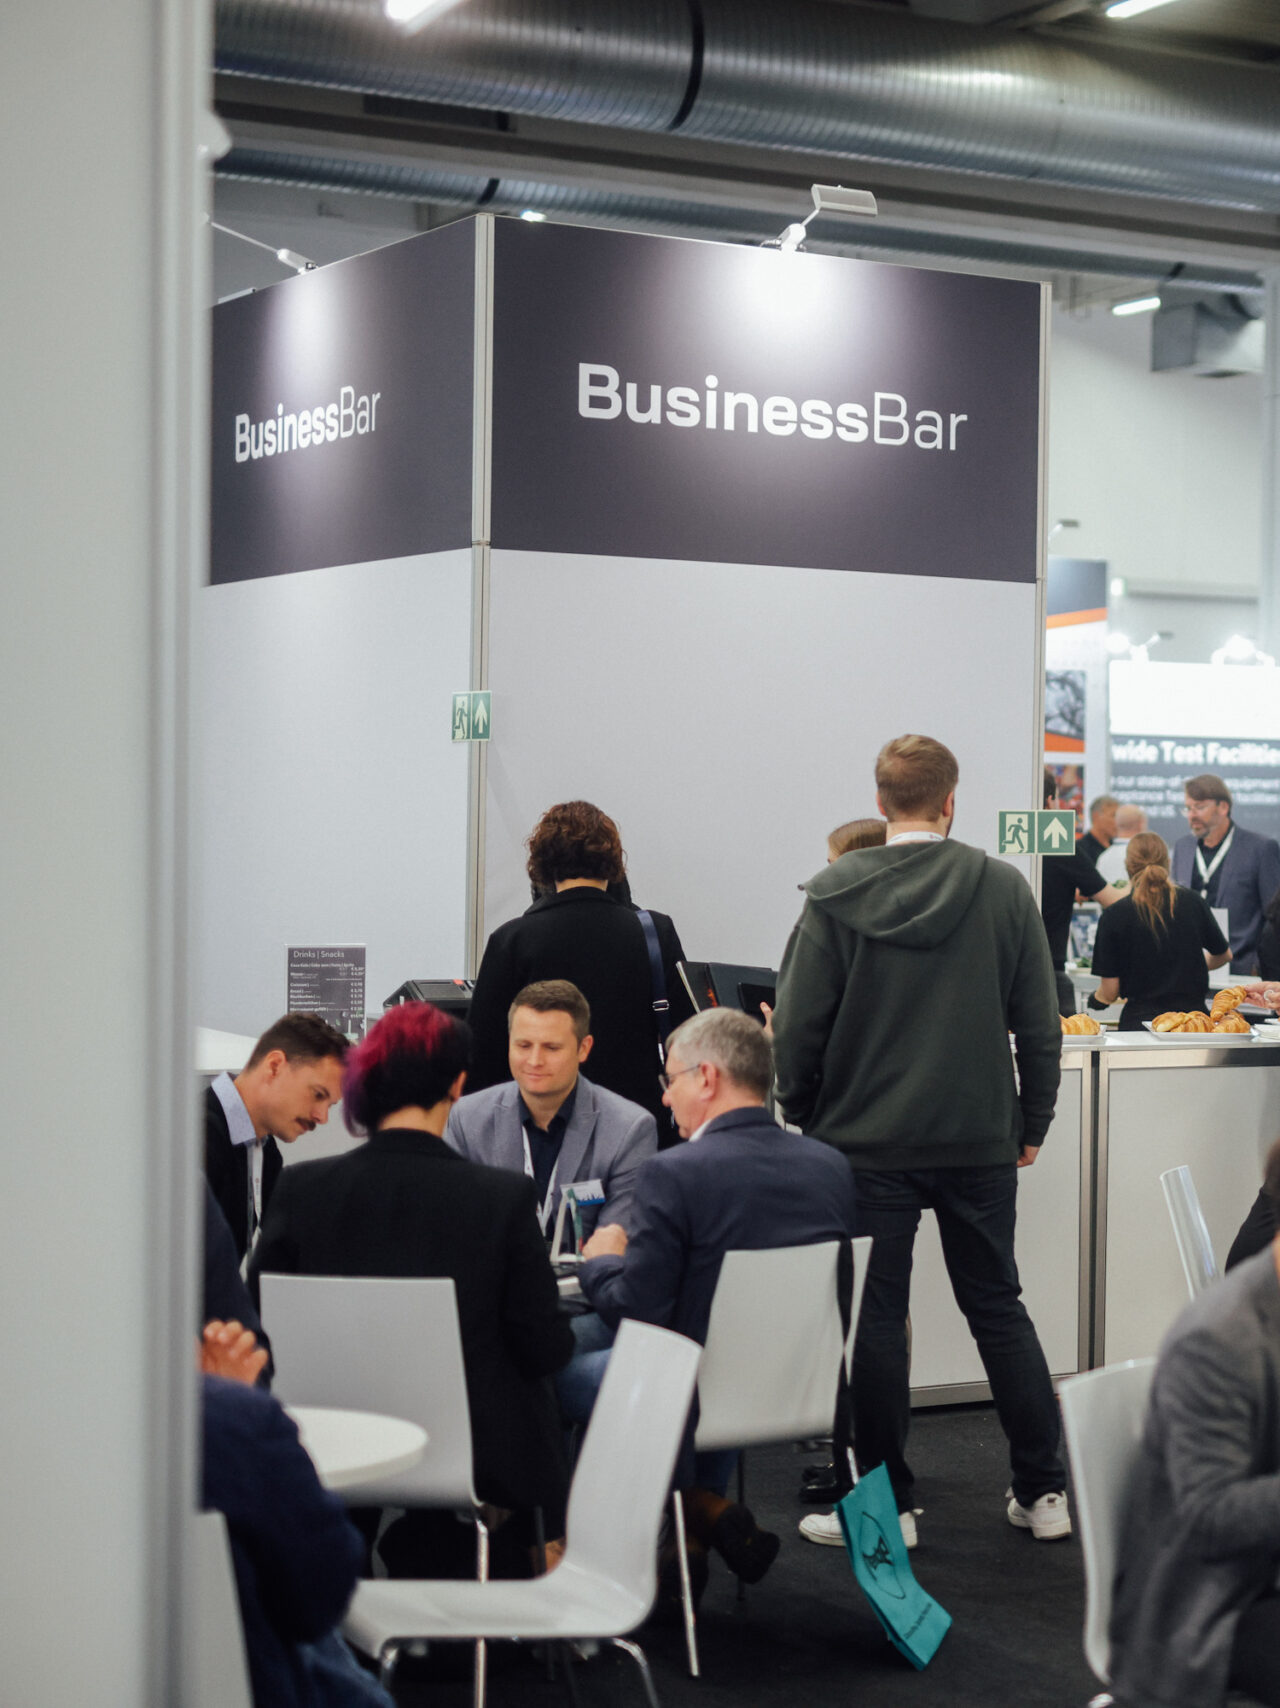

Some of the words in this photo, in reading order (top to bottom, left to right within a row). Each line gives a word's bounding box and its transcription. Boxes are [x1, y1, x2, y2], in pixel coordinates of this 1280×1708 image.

[234, 385, 381, 463] BusinessBar
[577, 362, 968, 452] BusinessBar
[1160, 741, 1204, 766] Test
[293, 950, 316, 959] Drinks
[320, 950, 345, 959] Snacks
